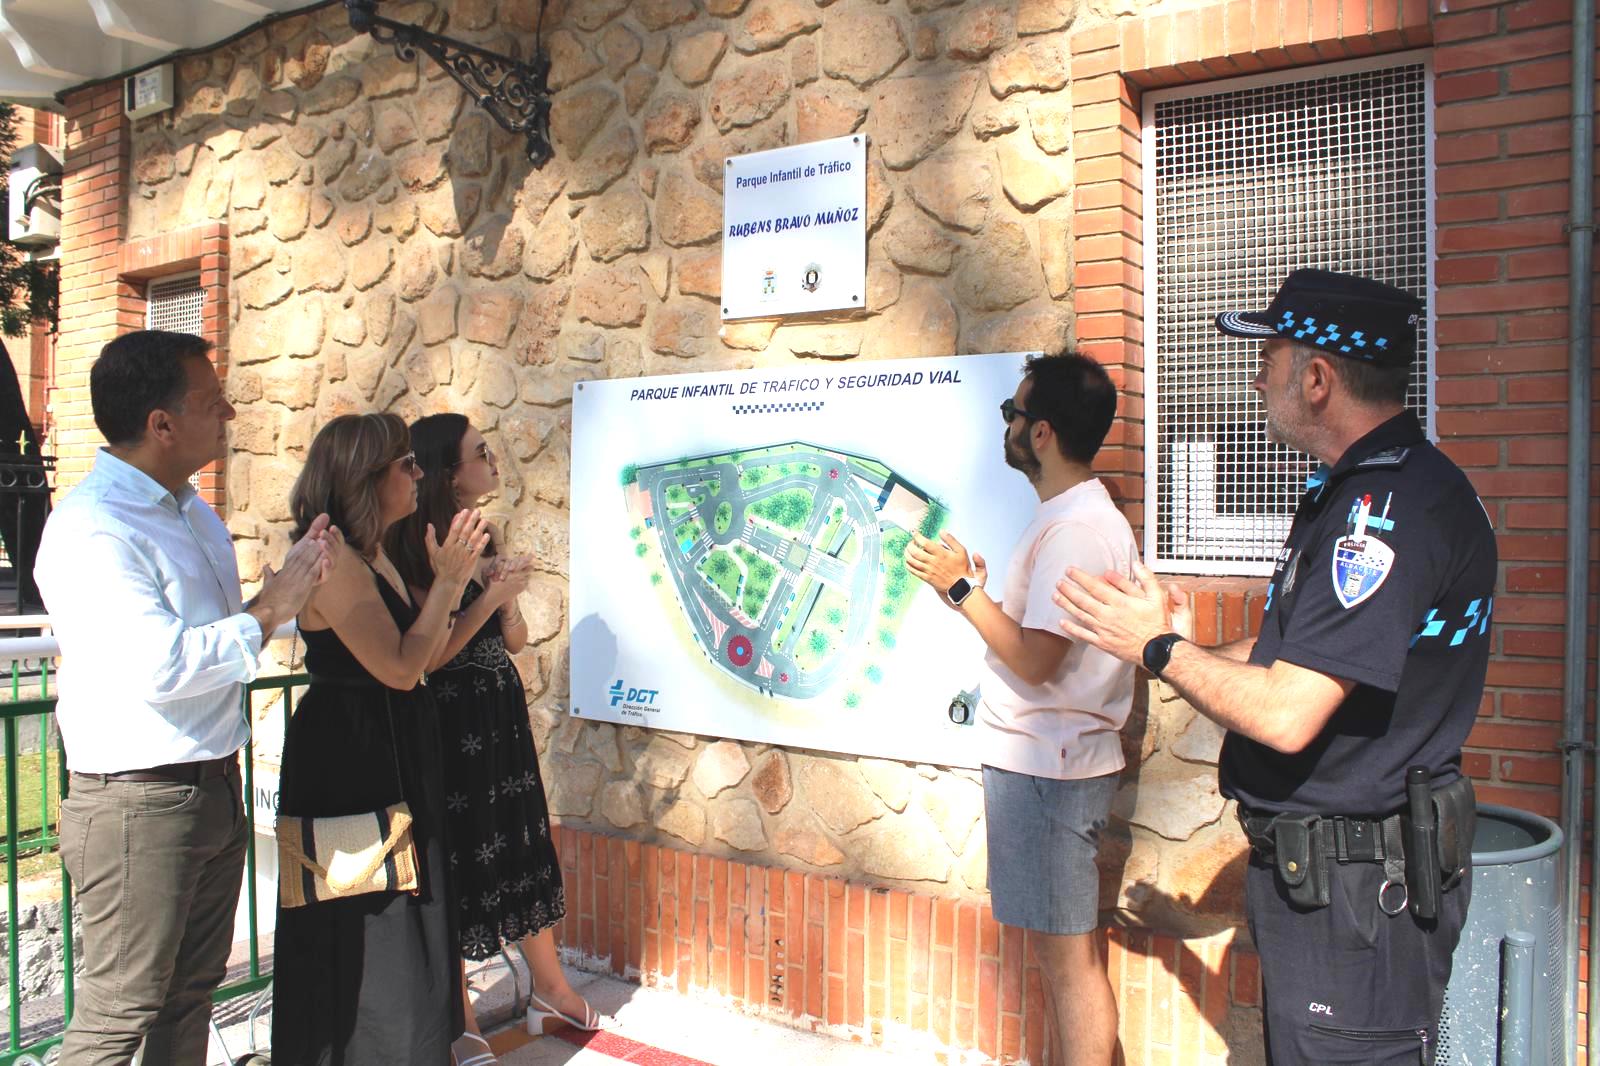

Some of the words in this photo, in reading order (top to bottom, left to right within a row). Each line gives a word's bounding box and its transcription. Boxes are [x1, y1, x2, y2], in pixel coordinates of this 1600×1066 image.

[736, 174, 768, 189] Parque
[770, 167, 801, 184] Infantil
[804, 165, 816, 178] de
[818, 160, 852, 176] Tráfico
[729, 219, 772, 238] RUBENS
[774, 214, 811, 233] BRAVO
[814, 206, 859, 226] MUÑOZ
[630, 386, 679, 401] PARQUE
[681, 383, 735, 398] INFANTIL
[740, 382, 758, 395] DE
[825, 377, 834, 389] Y
[837, 371, 924, 389] SEGURIDAD
[929, 369, 962, 385] VIAL
[626, 688, 659, 704] DGT
[1309, 1001, 1334, 1016] CPL
